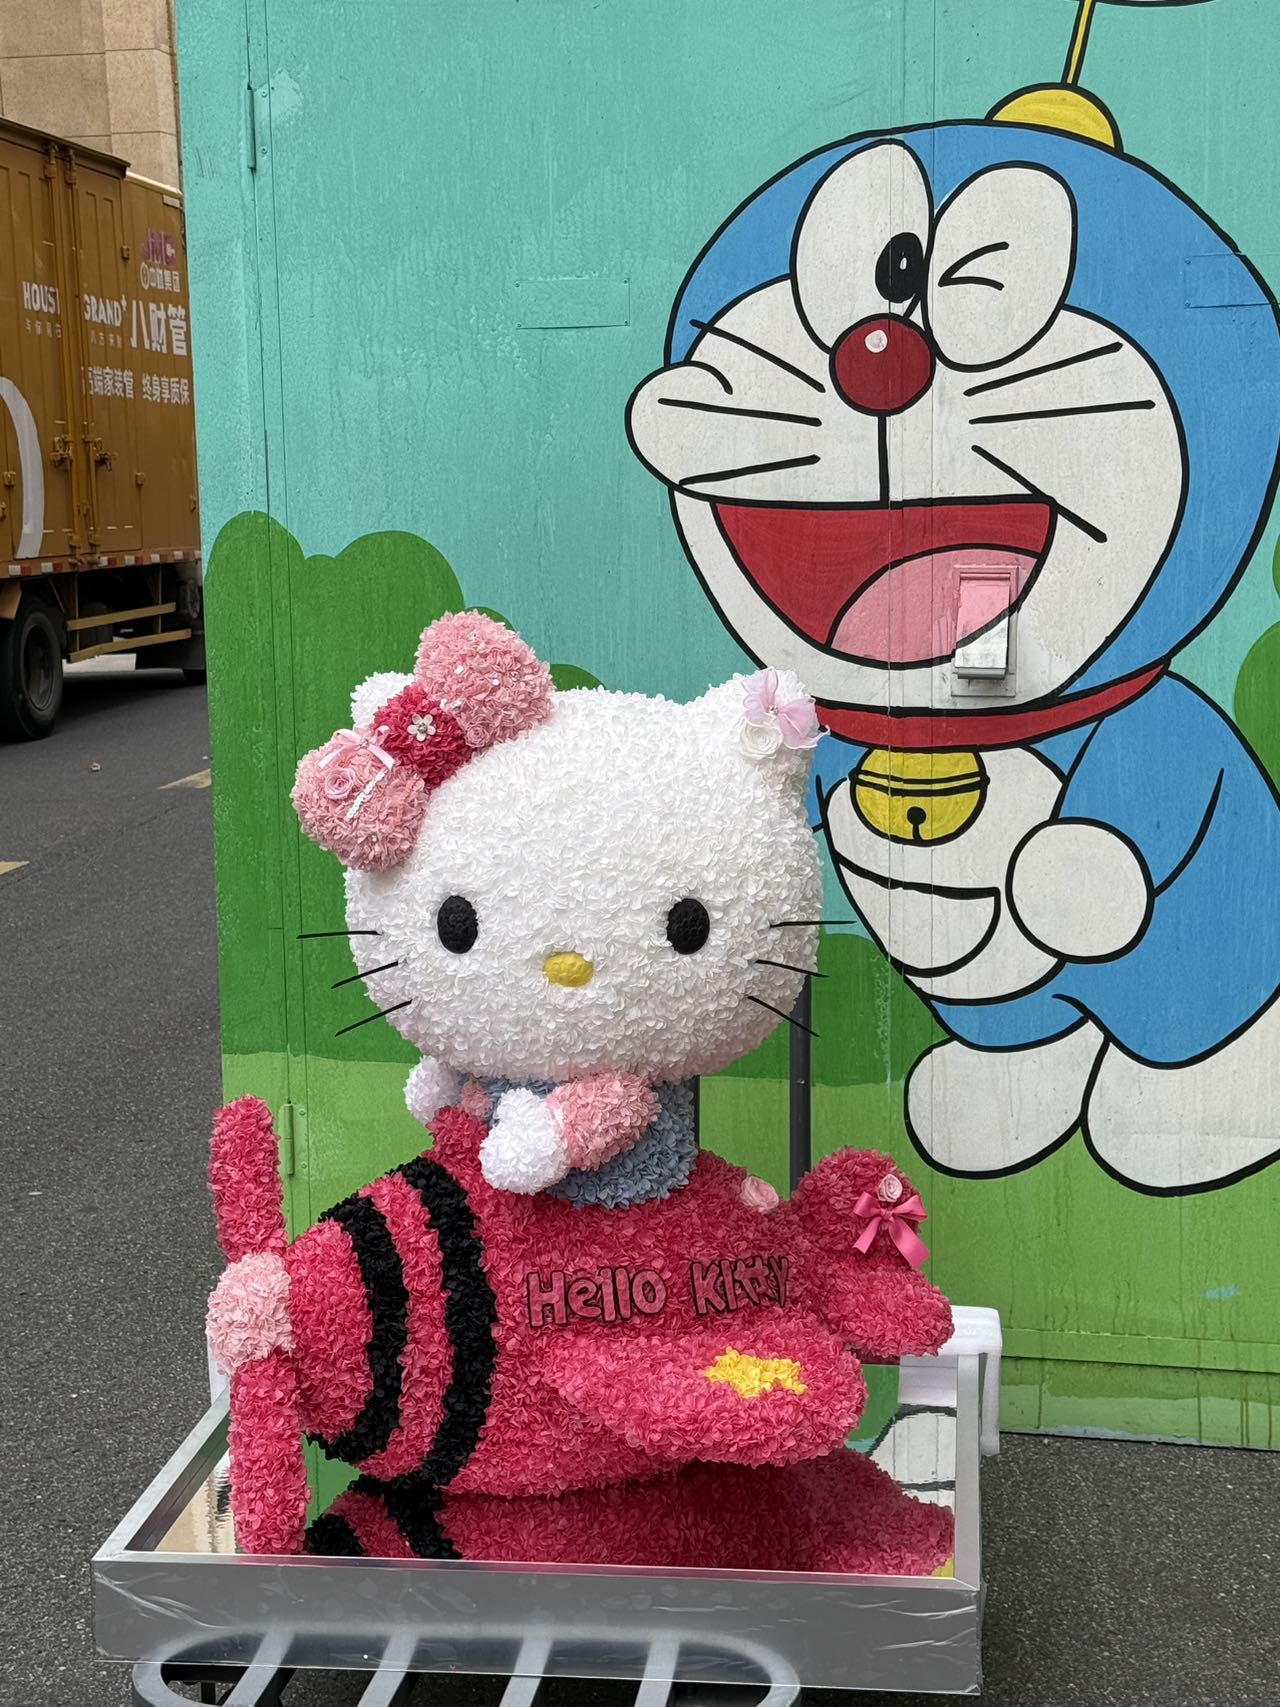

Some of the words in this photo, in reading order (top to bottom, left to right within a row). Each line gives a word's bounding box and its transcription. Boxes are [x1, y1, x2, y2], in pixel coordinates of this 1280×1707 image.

[142, 372, 190, 405] 终身享质保
[527, 1266, 667, 1329] Hello
